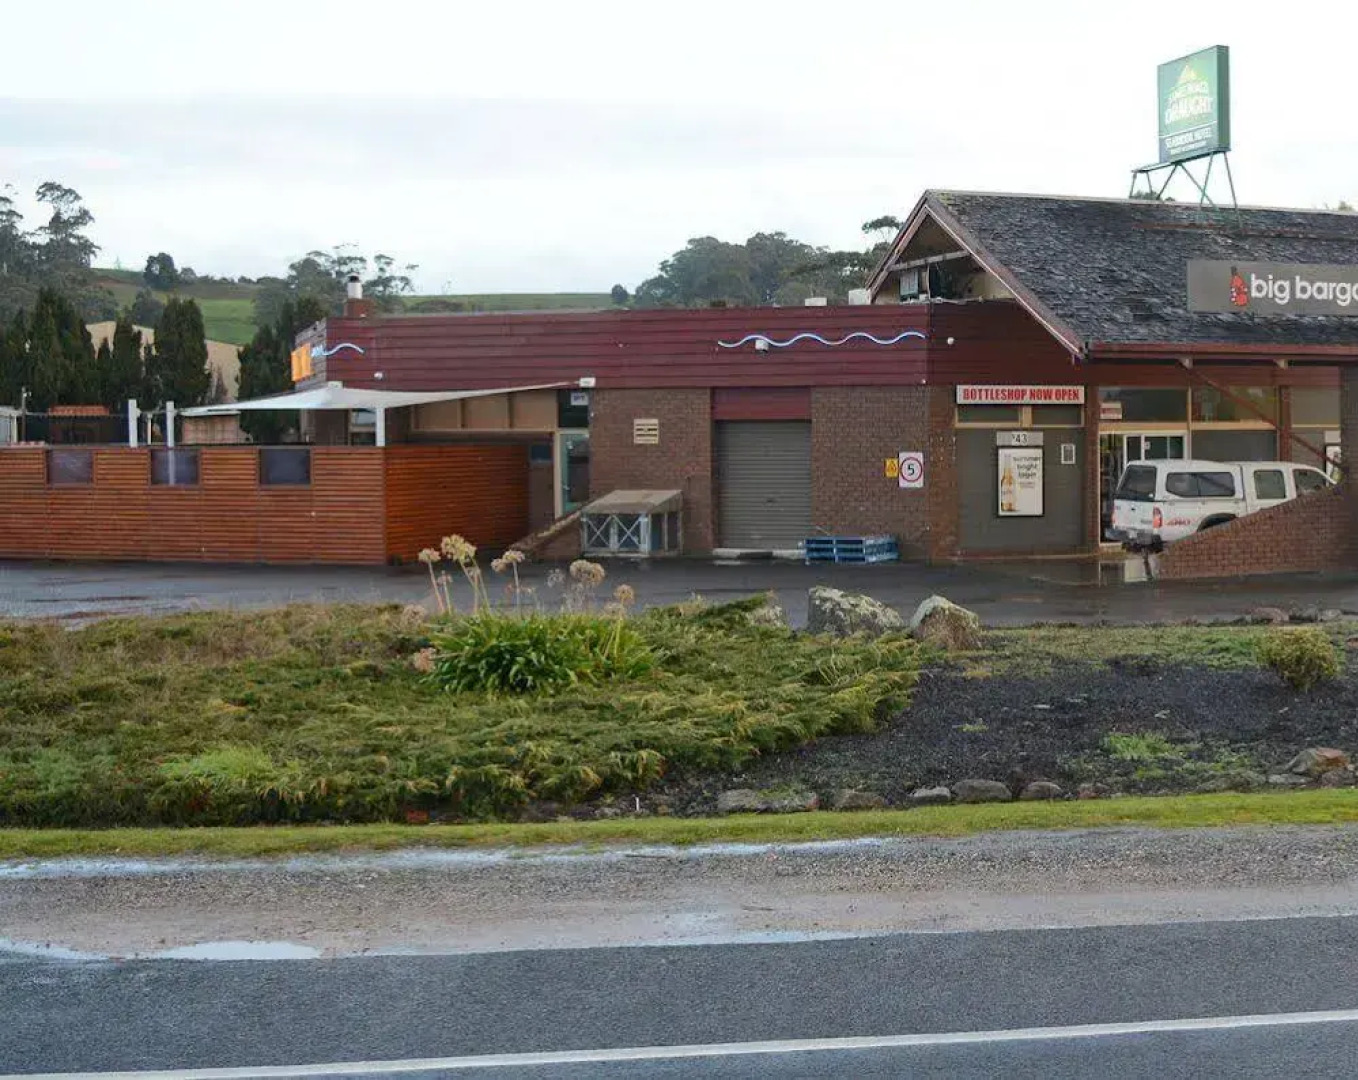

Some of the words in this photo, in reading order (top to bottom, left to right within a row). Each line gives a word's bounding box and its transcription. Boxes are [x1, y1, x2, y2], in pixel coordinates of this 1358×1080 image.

[1251, 273, 1290, 304] big
[963, 388, 1026, 401] BOTTLESHOP
[1029, 388, 1051, 401] NOW
[1055, 389, 1080, 401] OPEN
[907, 463, 915, 477] 5
